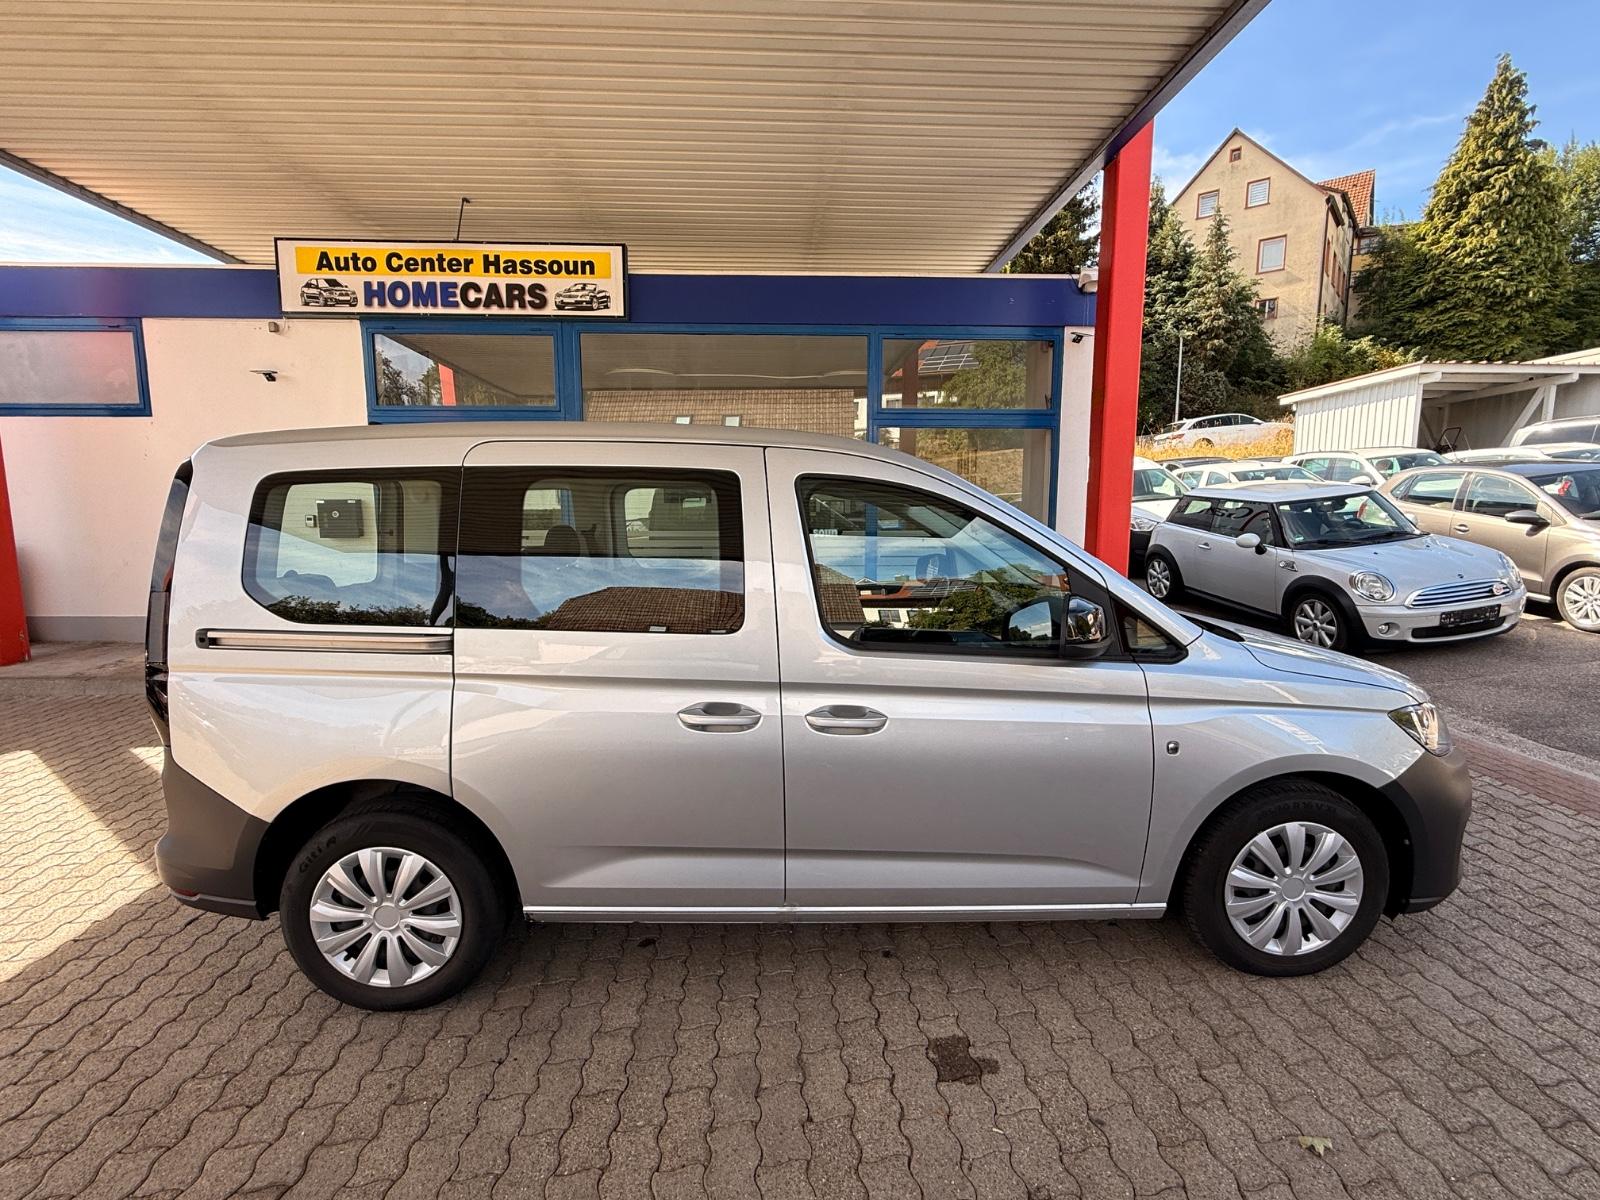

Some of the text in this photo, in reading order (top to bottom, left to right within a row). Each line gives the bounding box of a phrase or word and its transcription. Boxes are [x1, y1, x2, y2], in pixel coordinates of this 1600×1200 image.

[316, 251, 596, 276] Auto Center Hassoun
[363, 280, 548, 310] HOMECARS
